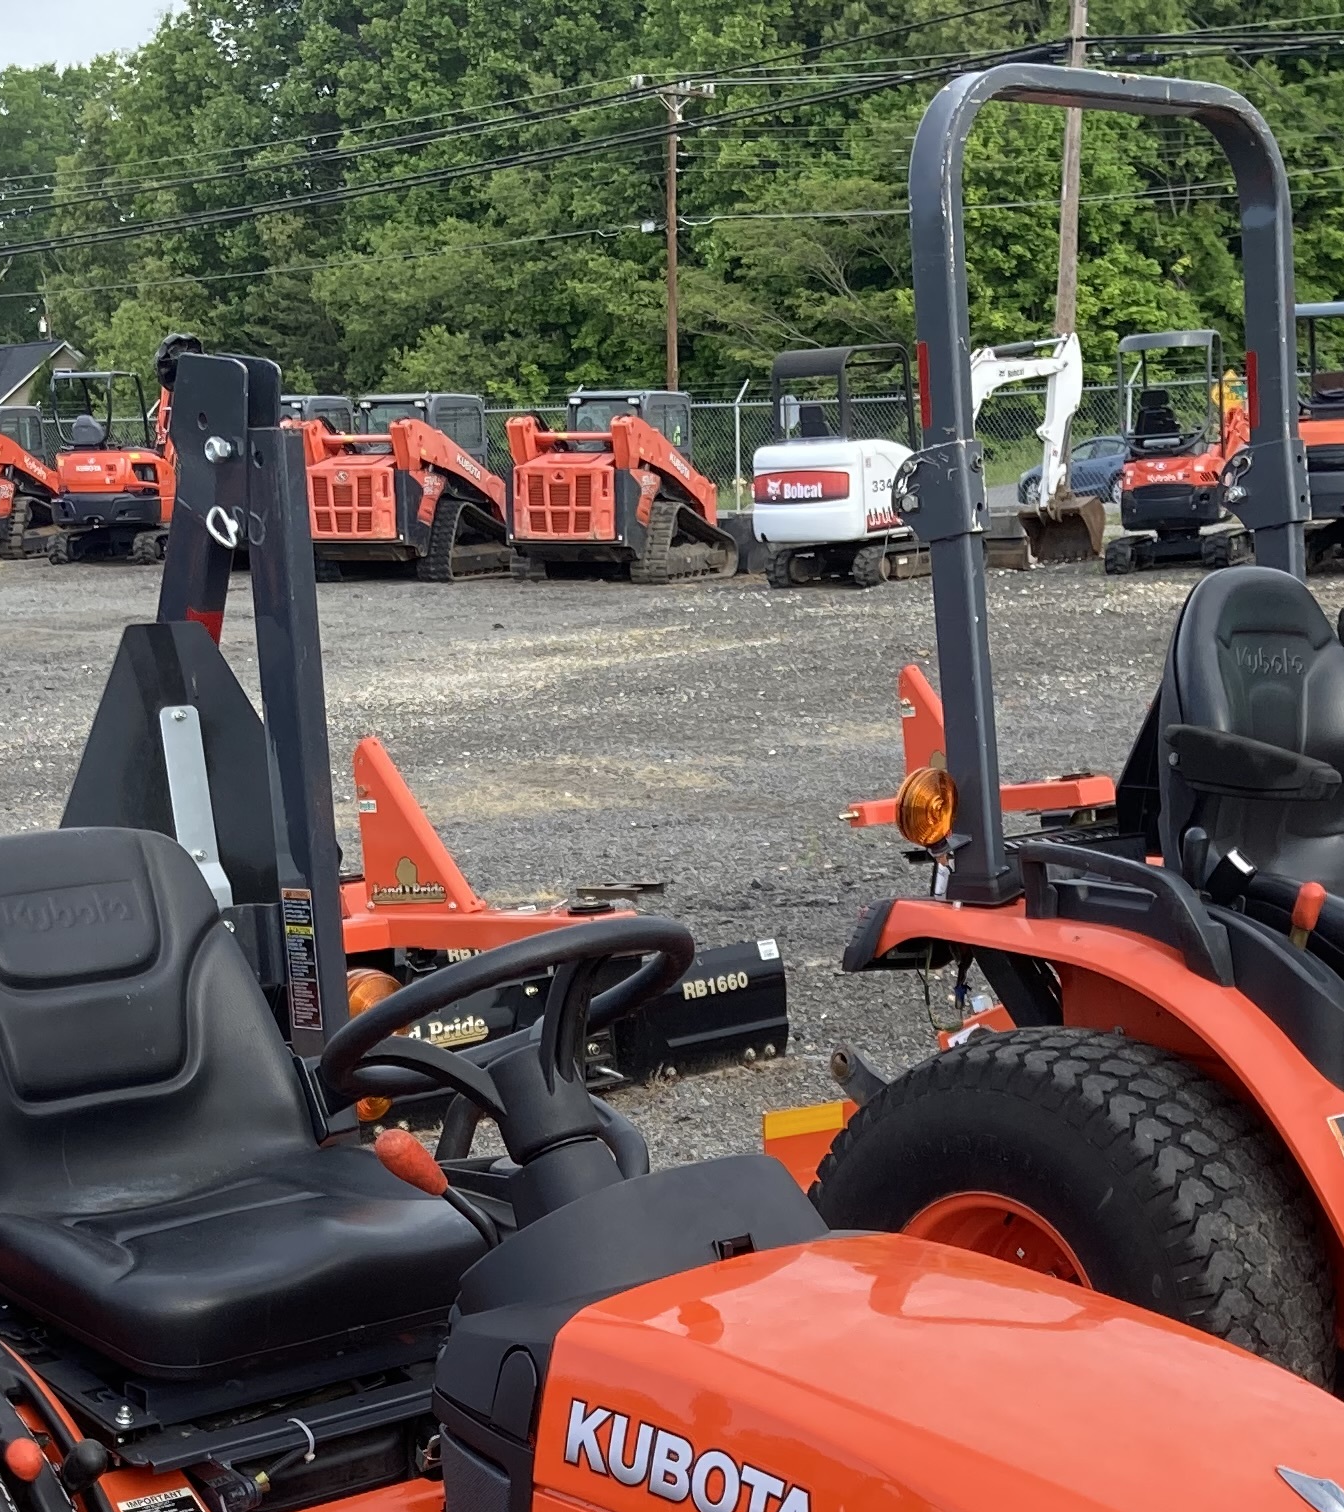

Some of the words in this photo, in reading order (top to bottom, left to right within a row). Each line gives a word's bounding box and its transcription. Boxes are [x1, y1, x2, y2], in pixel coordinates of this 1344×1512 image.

[456, 452, 481, 480] KUBOTA
[783, 482, 822, 500] Bobcat
[1236, 646, 1304, 674] Kubota
[682, 971, 749, 1000] RB1660
[429, 1016, 486, 1042] Pride
[126, 1489, 182, 1508] IMPORTANT
